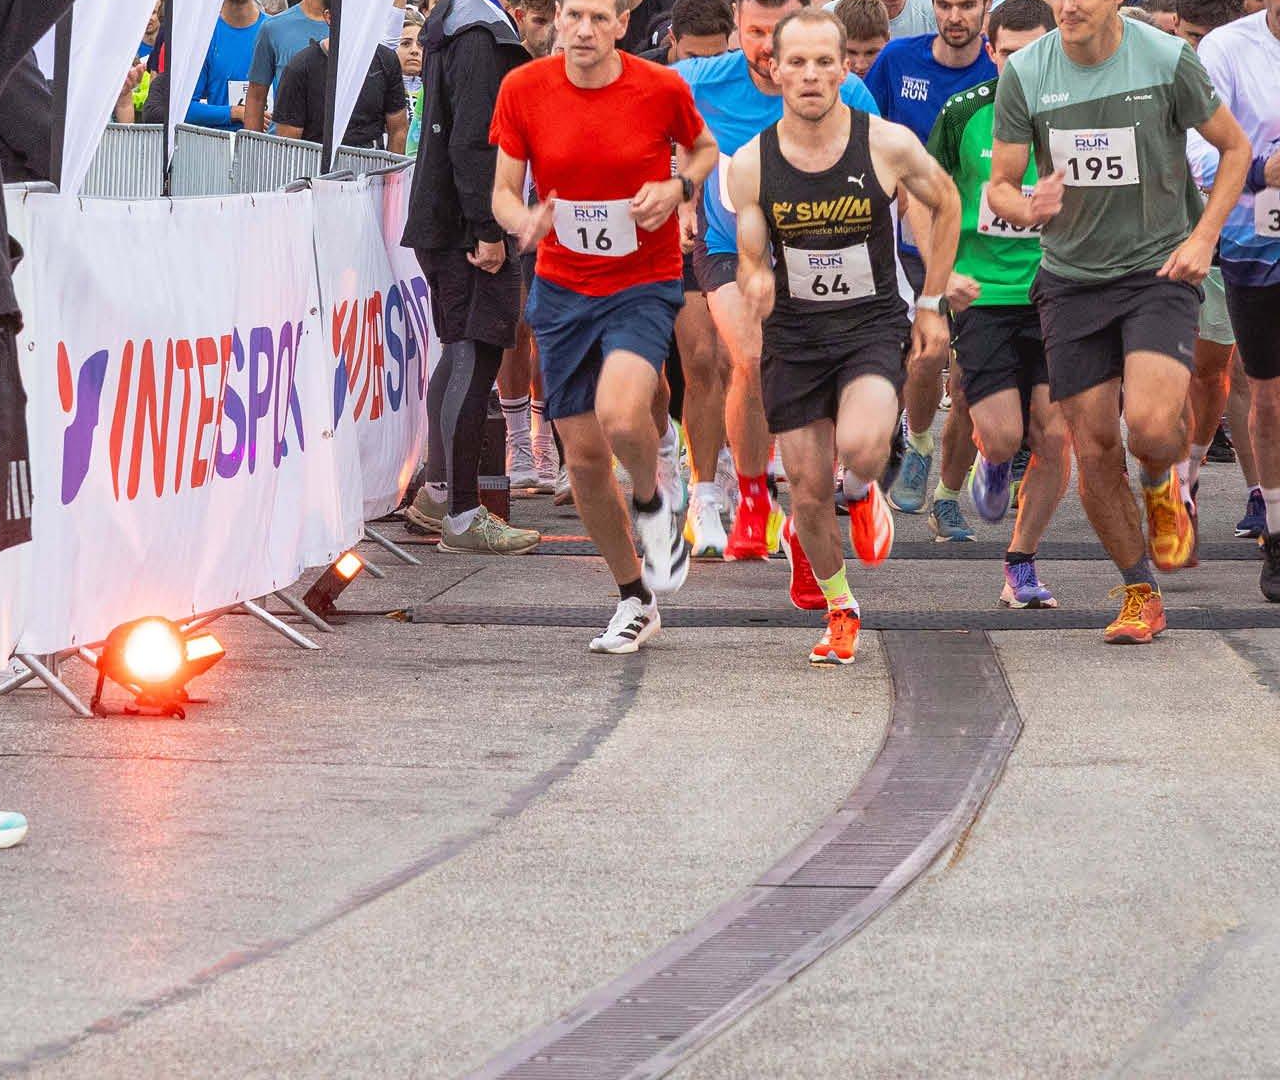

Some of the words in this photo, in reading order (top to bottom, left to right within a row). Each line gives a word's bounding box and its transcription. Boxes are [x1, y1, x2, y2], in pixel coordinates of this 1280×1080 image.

[901, 87, 928, 101] RUN
[1075, 137, 1109, 147] RUN
[1067, 156, 1124, 181] 195
[574, 209, 608, 219] RUN
[577, 227, 613, 250] 16
[808, 257, 843, 266] RUN
[812, 274, 850, 296] 64
